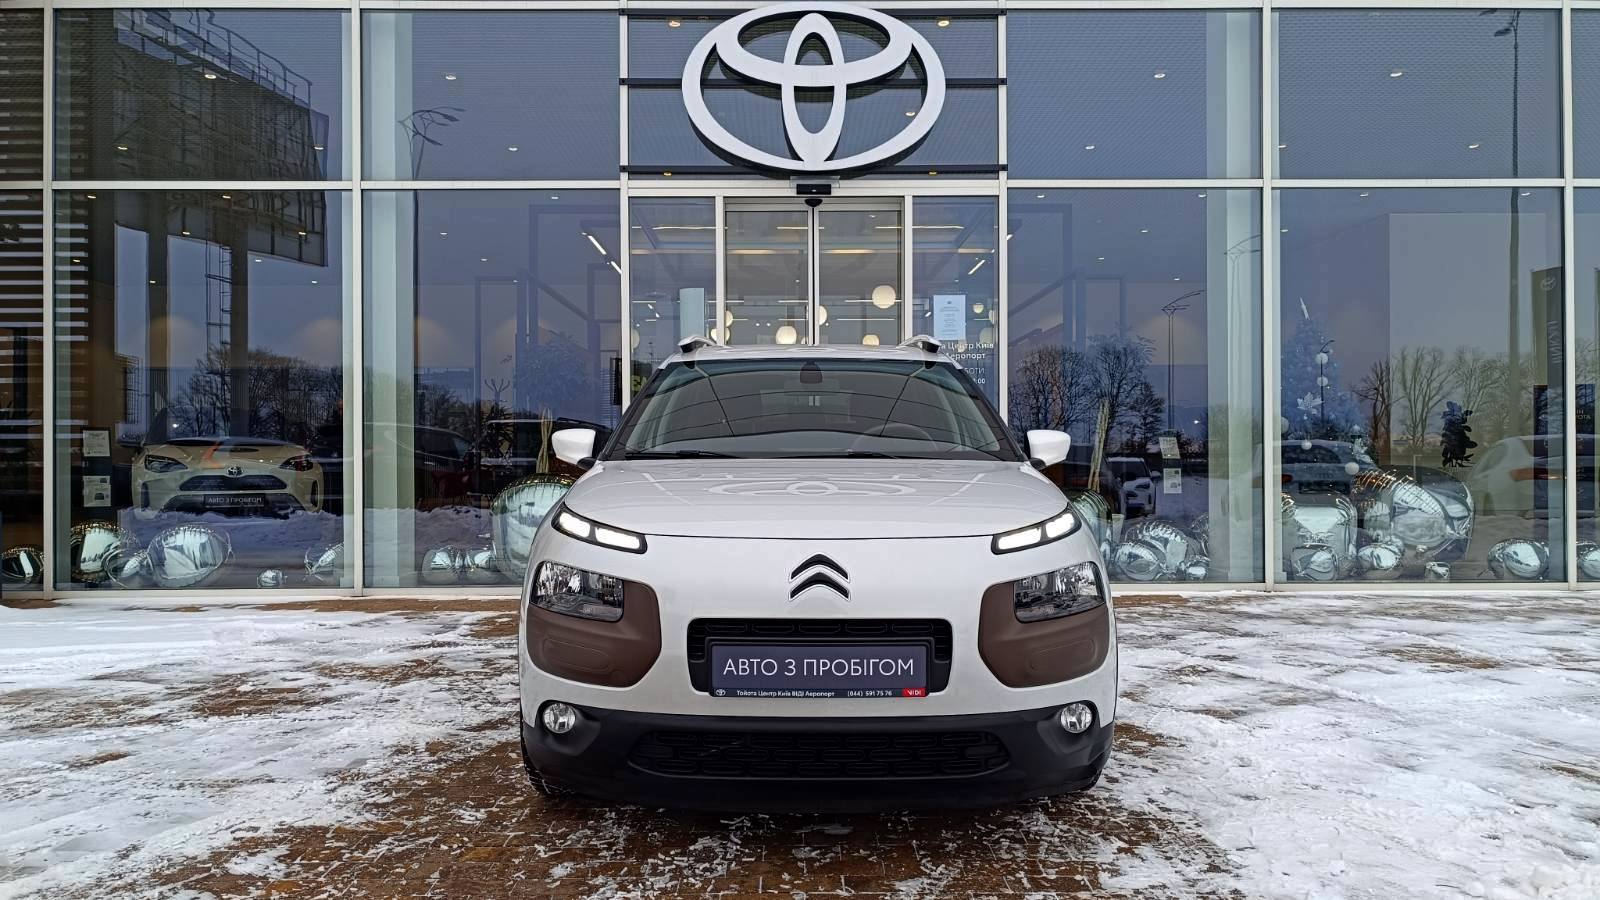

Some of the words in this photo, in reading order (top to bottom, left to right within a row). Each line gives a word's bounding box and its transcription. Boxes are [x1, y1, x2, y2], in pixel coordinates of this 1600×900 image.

[722, 658, 778, 676] АВТО
[784, 658, 796, 676] З
[803, 658, 914, 676] ПРОБІГОМ
[736, 689, 757, 697] Тойота
[777, 689, 791, 697] Київ
[805, 690, 835, 698] Аеропорт
